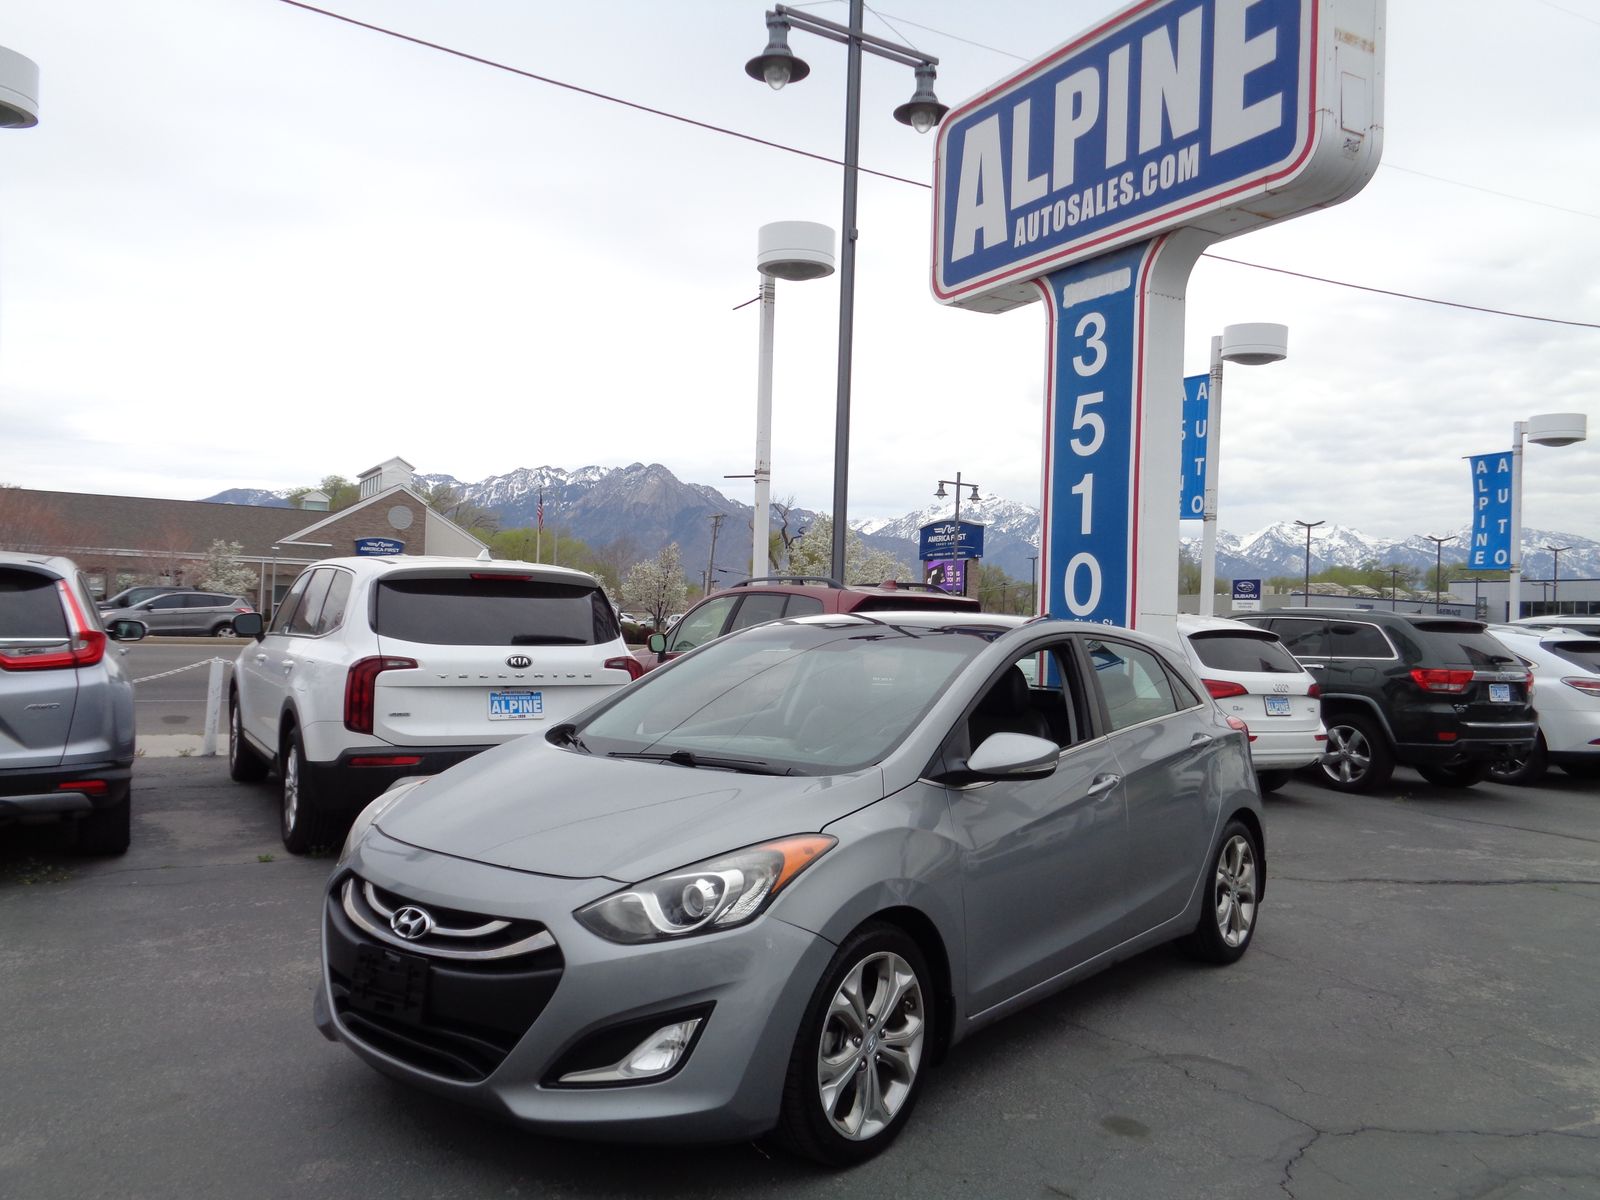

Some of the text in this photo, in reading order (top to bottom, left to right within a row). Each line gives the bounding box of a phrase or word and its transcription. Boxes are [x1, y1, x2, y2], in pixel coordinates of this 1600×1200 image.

[951, 0, 1283, 263] ALPINE
[1014, 143, 1200, 248] AUTOSALES.COM
[1064, 312, 1108, 617] 3510
[1191, 382, 1208, 514] AUTO
[927, 533, 966, 543] AMERICA FST
[1474, 460, 1488, 565] ALPINE
[1494, 458, 1509, 565] AUTO
[491, 700, 542, 714] ALPINE
[510, 657, 529, 666] KIA
